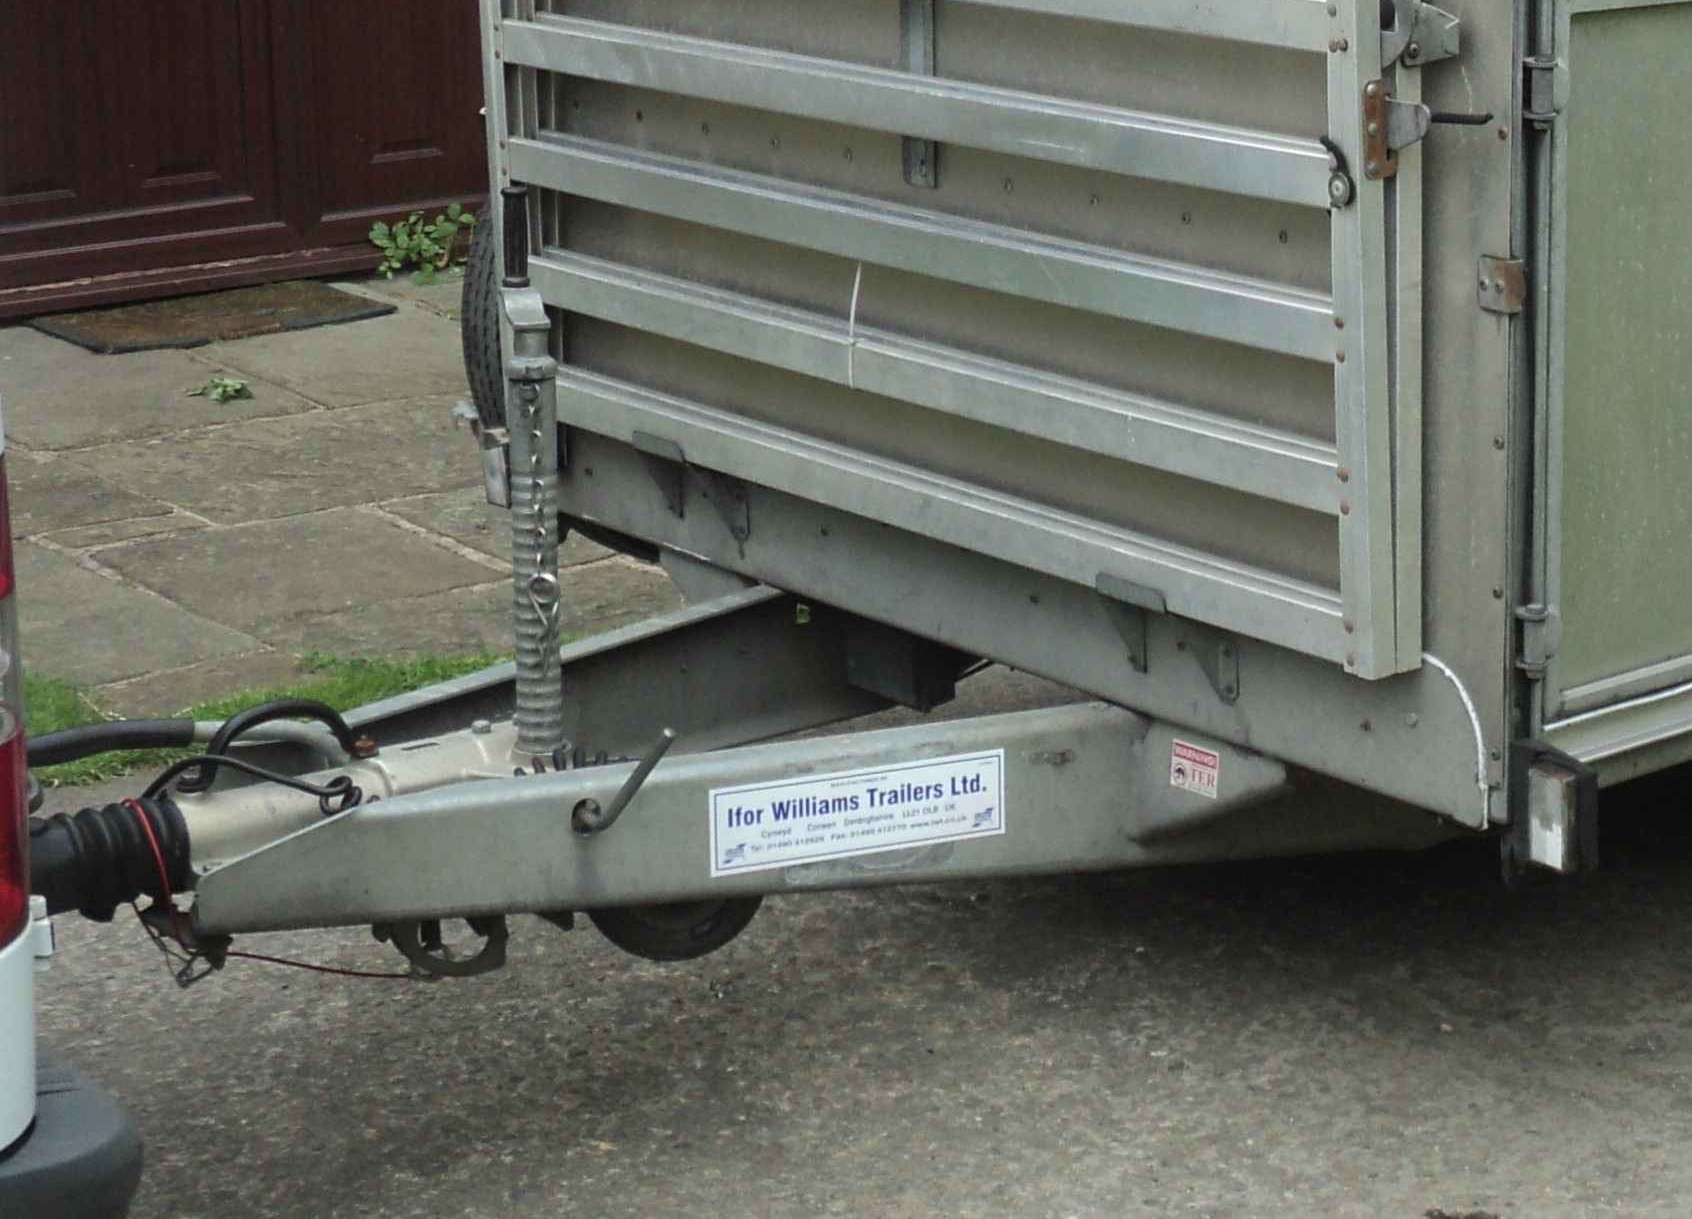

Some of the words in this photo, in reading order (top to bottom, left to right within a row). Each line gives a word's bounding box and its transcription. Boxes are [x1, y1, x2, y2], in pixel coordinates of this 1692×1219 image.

[727, 806, 763, 828] Ifor
[771, 795, 860, 821] Williams
[866, 782, 943, 808] Trailers
[951, 773, 987, 796] Ltd.
